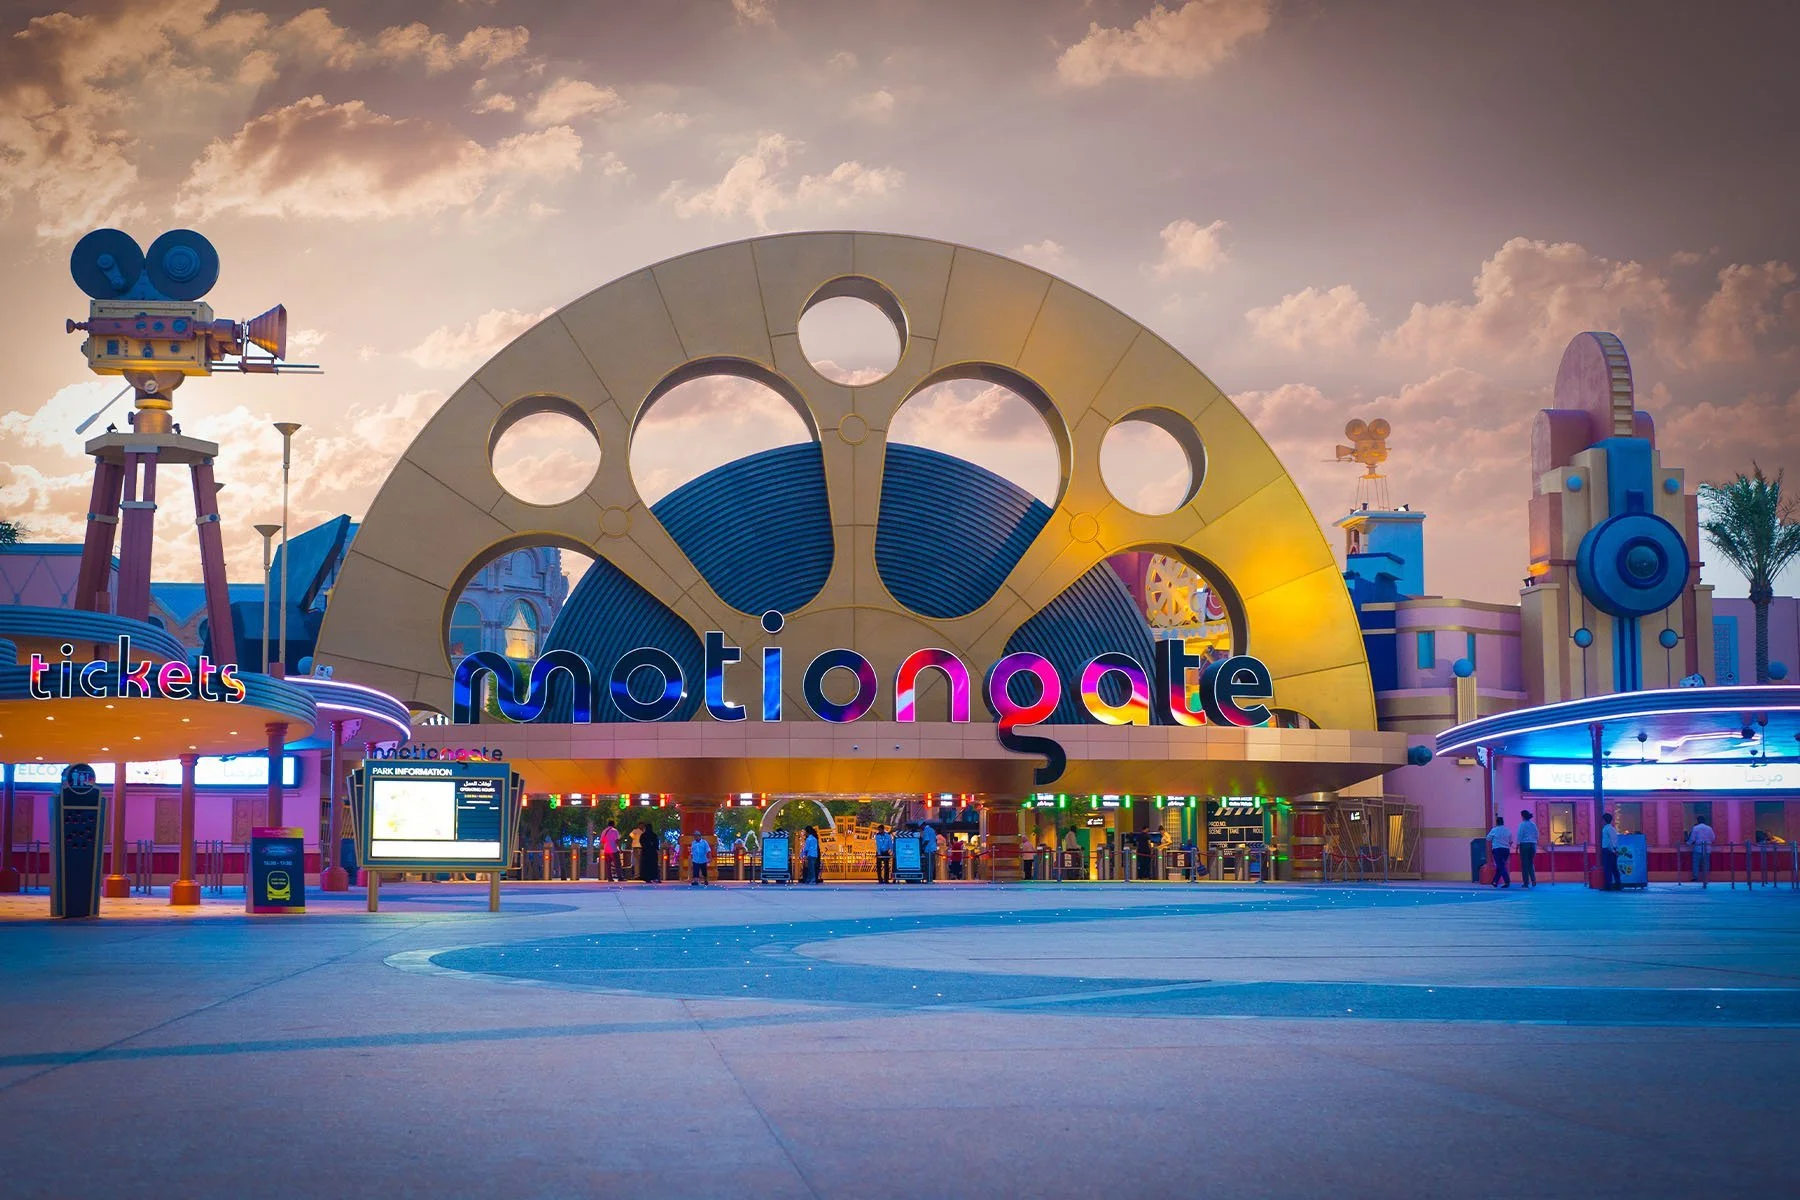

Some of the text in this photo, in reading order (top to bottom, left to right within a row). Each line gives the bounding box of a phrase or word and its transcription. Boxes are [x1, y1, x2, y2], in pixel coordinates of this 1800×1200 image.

[29, 634, 246, 703] tickets
[453, 610, 1274, 785] motiongate
[372, 767, 453, 776] PARK INFORMATION
[373, 743, 503, 769] motiongate
